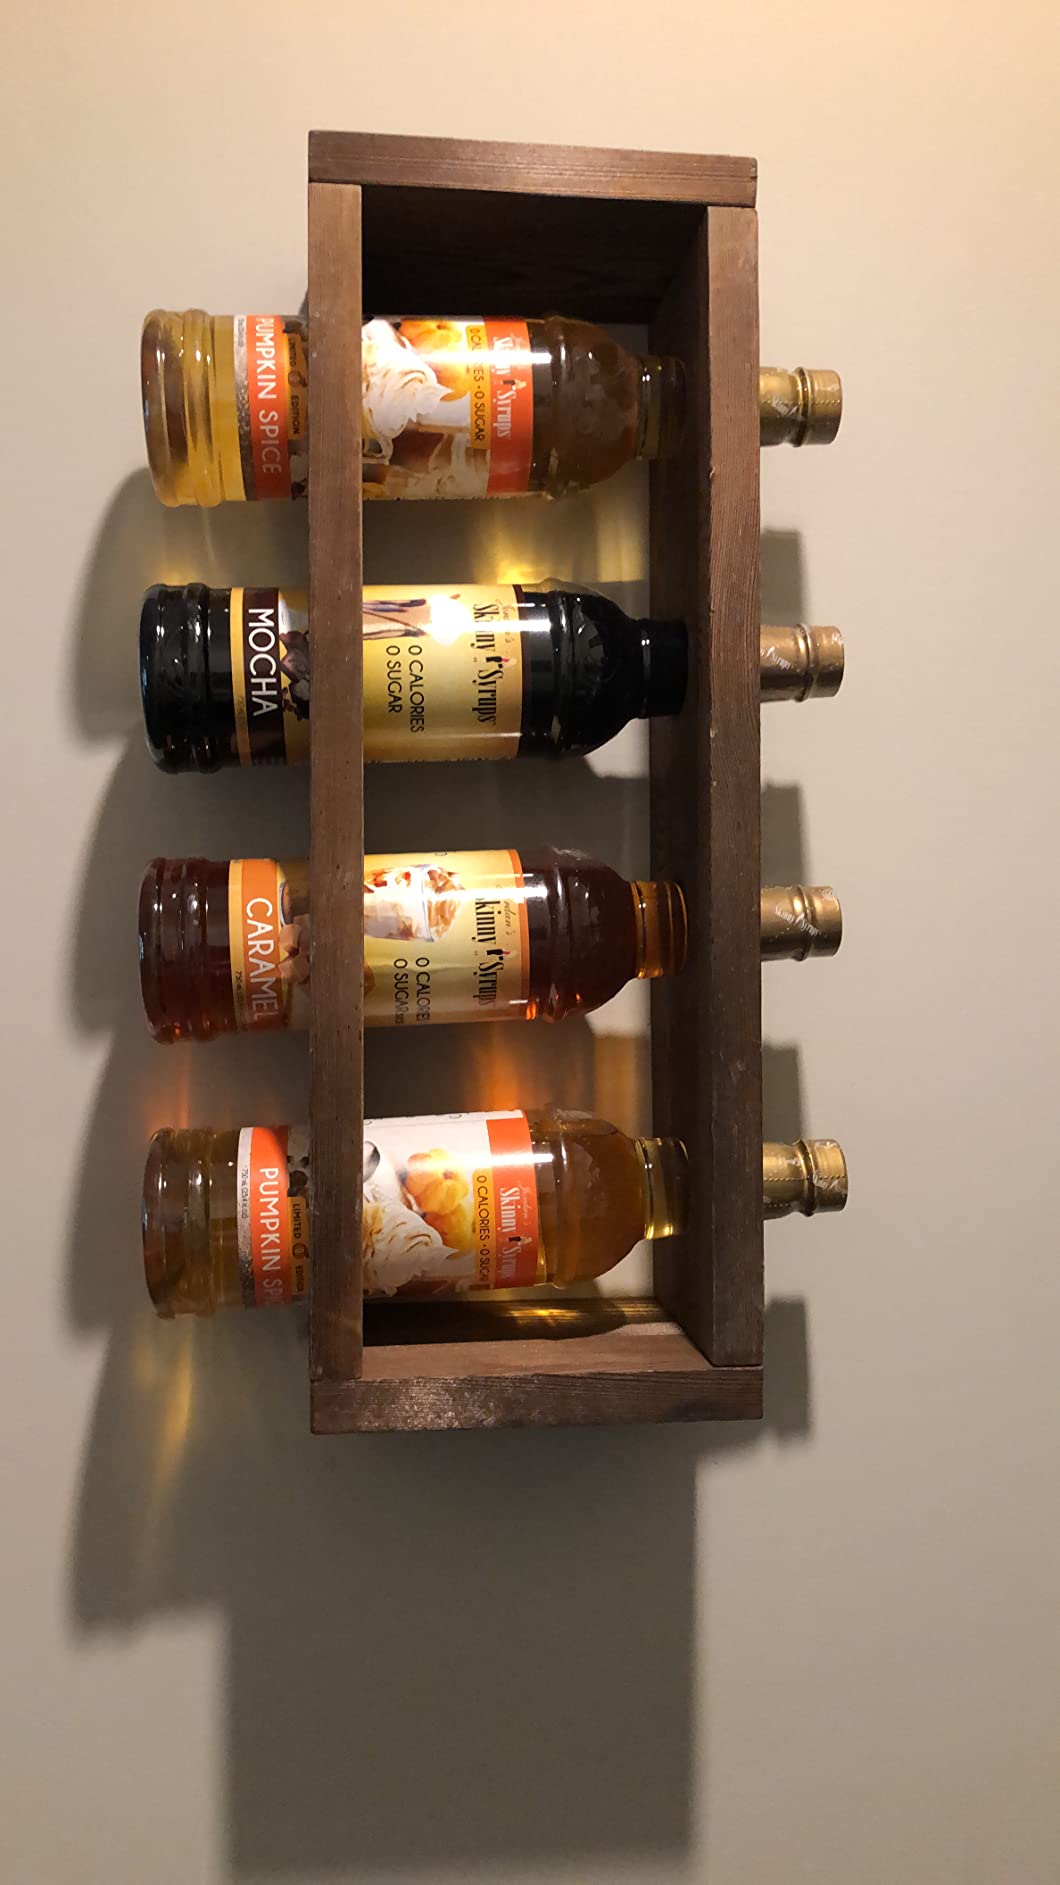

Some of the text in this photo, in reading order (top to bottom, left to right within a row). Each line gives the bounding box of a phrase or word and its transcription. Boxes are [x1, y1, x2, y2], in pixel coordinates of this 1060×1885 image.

[256, 317, 282, 474] PUMPKIN SPICE
[291, 395, 301, 434] EDITION
[474, 402, 486, 441] SUGAR
[248, 608, 279, 717] MOCHA
[386, 660, 403, 713] SUGAR
[408, 659, 425, 733] CALORIES
[472, 669, 504, 723] Syrups
[246, 897, 279, 1022] CARAMEL
[394, 973, 409, 1013] SUGAR
[259, 1167, 281, 1271] PUMPKIN
[292, 1203, 302, 1239] LIMITED
[477, 1185, 490, 1242] CALORIES
[497, 1187, 521, 1233] Skinny
